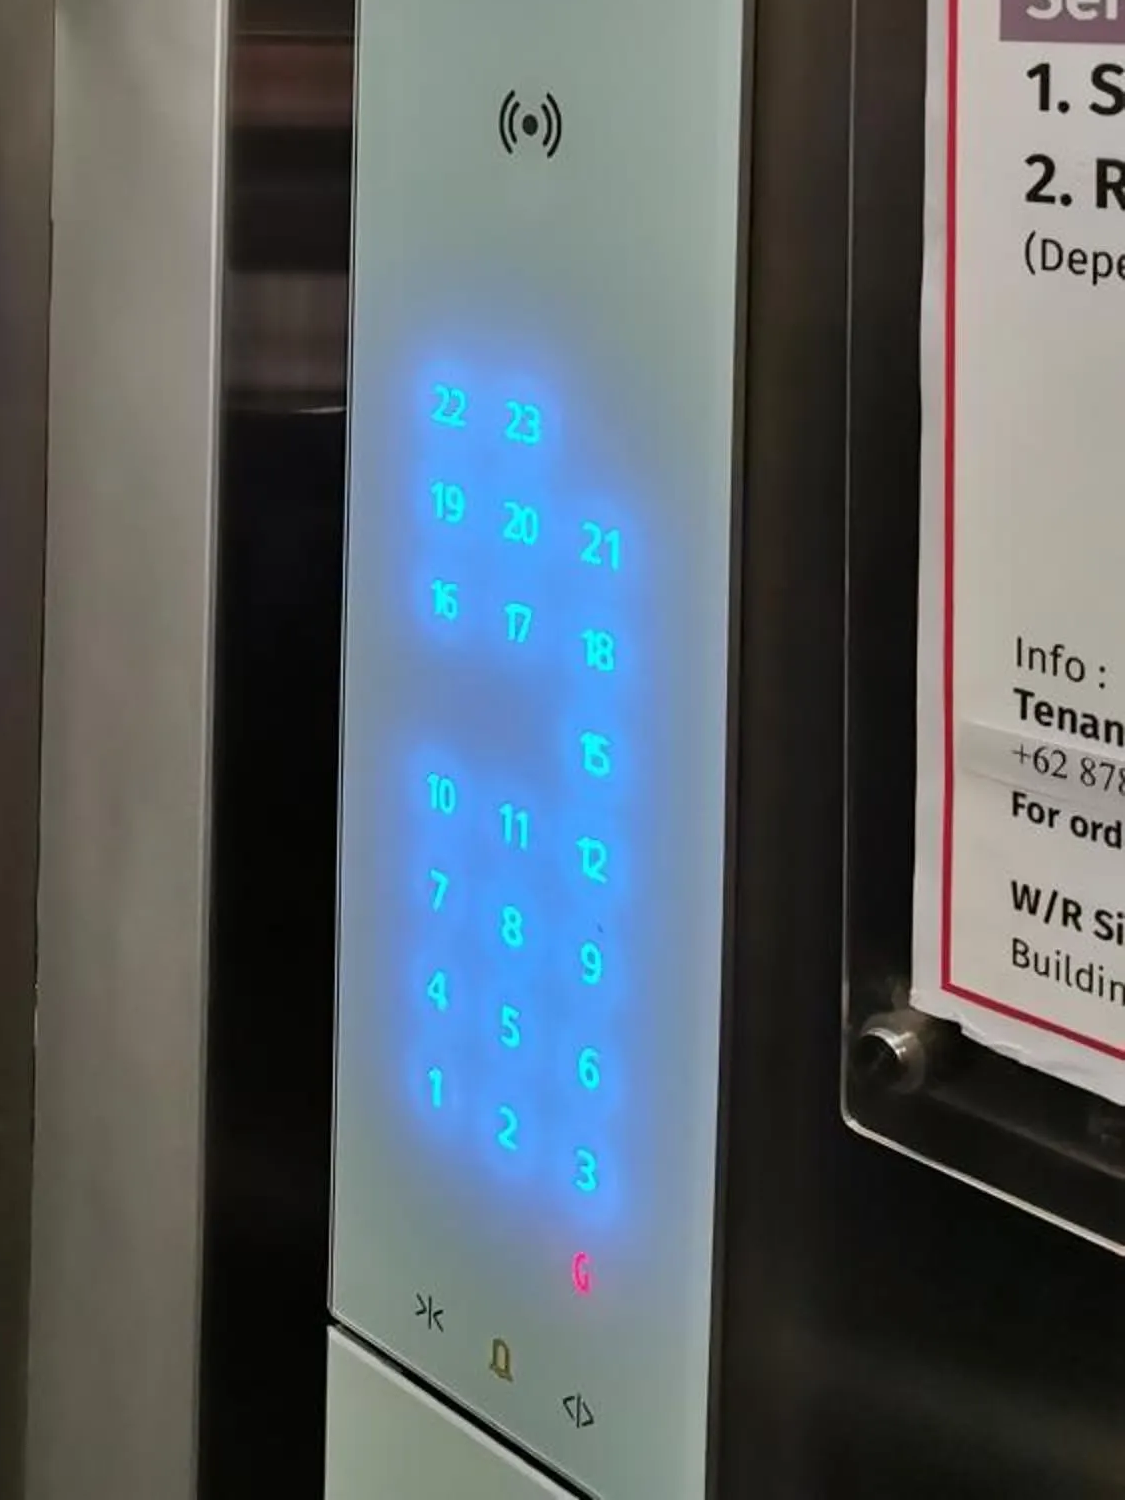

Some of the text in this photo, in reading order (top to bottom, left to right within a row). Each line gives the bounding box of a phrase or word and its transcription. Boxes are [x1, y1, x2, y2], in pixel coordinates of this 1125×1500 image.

[1026, 62, 1070, 114] 1.
[1024, 153, 1073, 207] 2.
[430, 384, 468, 428] 22
[505, 400, 541, 445] 23
[430, 481, 466, 524] 19
[503, 501, 540, 545] 20
[579, 521, 621, 571] 21
[431, 579, 459, 620] 16
[504, 603, 533, 643] 17
[581, 629, 615, 672] 18
[1015, 635, 1086, 683] Info
[1012, 687, 1125, 748] Tenan
[1011, 743, 1068, 780] +62
[426, 772, 456, 815] 10
[499, 803, 529, 850] 11
[1011, 790, 1122, 850] For ord
[575, 835, 608, 884] 12
[429, 868, 449, 912] 7
[1011, 879, 1082, 933] W/R
[500, 904, 523, 948] 8
[580, 941, 602, 985] 9
[1011, 937, 1125, 1007] Buildin
[427, 970, 449, 1012] 4
[500, 1004, 522, 1048] 5
[428, 1066, 443, 1108] 1
[578, 1047, 601, 1090] 6
[497, 1105, 519, 1150] 2
[575, 1148, 598, 1192] 3
[571, 1251, 592, 1294] G
